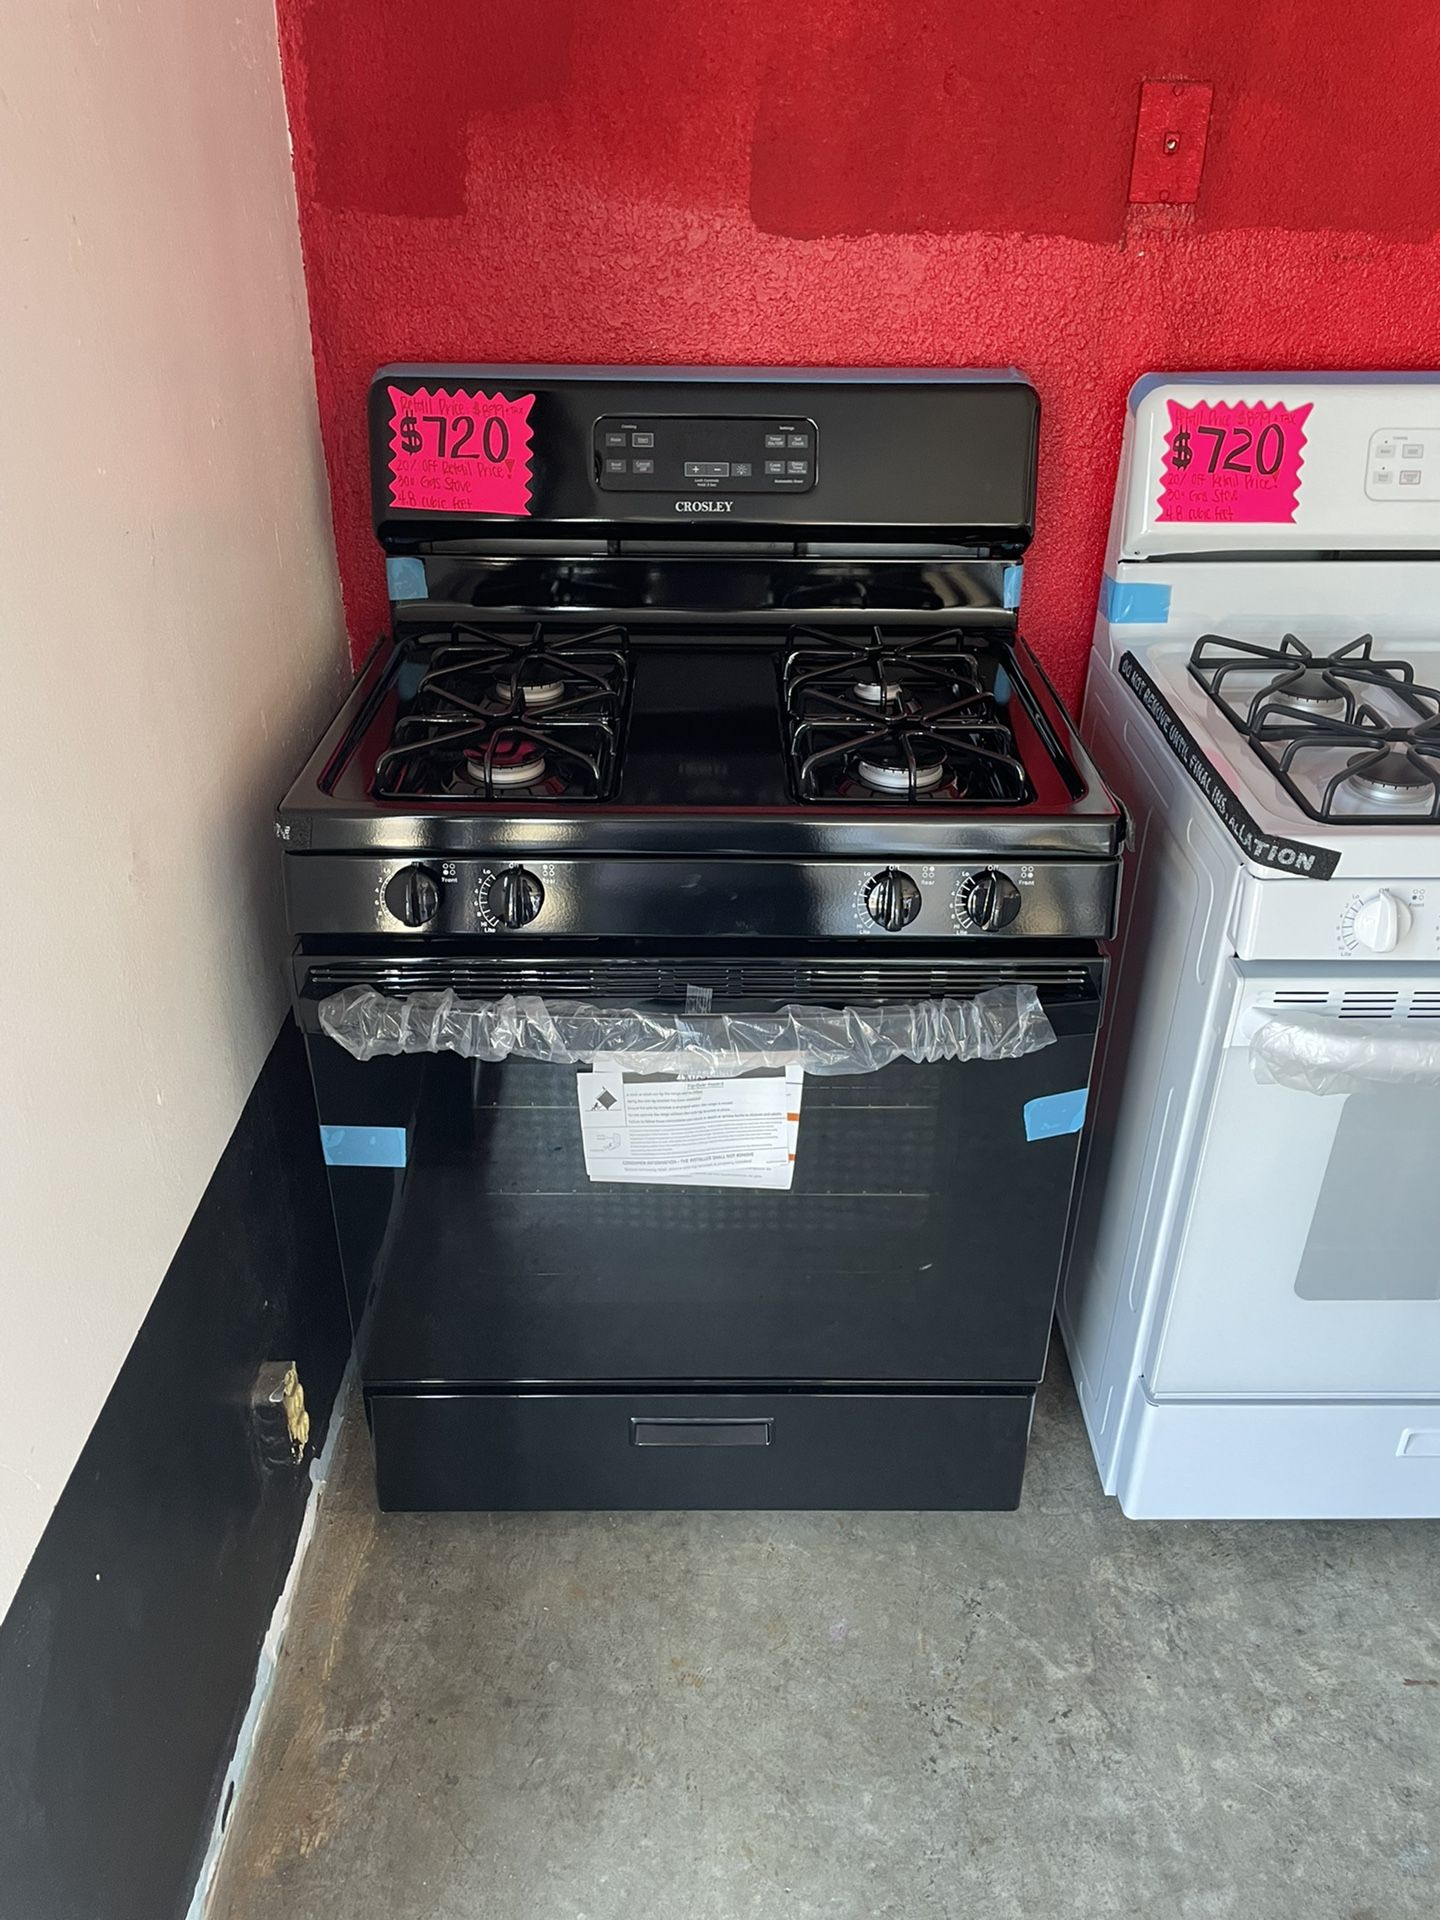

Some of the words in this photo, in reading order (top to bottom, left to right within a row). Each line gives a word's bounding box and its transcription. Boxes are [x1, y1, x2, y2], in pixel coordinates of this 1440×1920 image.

[439, 399, 464, 415] Price
[400, 410, 509, 463] $720
[1172, 423, 1285, 474] $720
[442, 461, 473, 477] Retail
[444, 477, 472, 493] Stove
[1212, 475, 1239, 488] Retail
[452, 499, 472, 510] feet
[675, 501, 734, 512] CROSLEY
[1121, 659, 1133, 678] DO
[1129, 670, 1147, 696] NOT
[1143, 687, 1172, 733] REMOVE
[1168, 725, 1190, 763] UNTIL
[1189, 754, 1212, 795] FINAL
